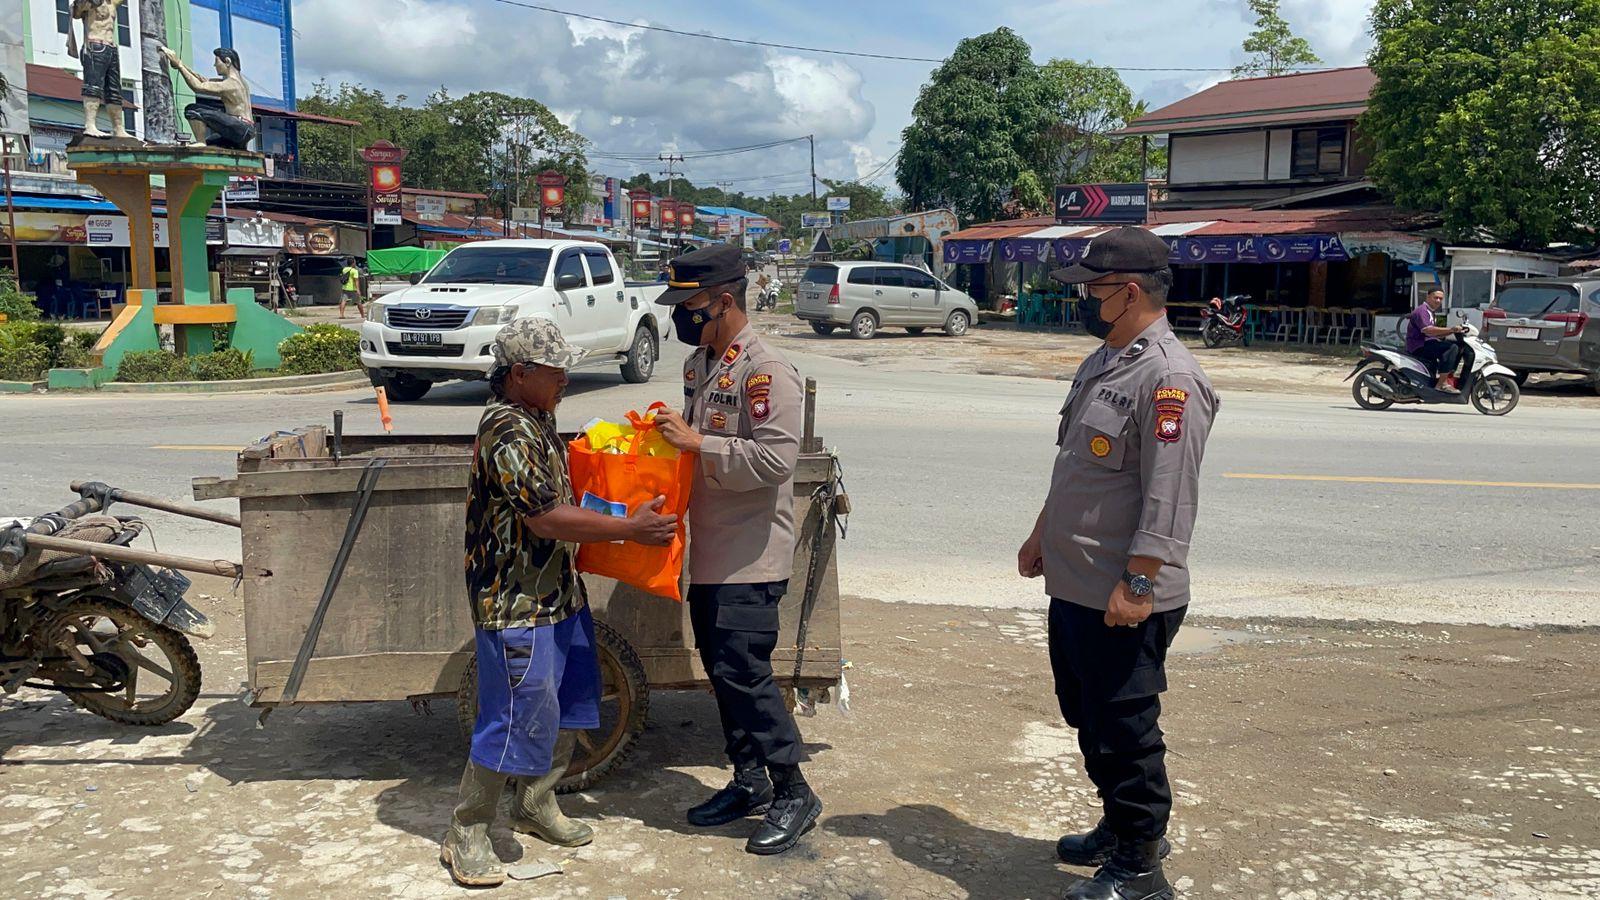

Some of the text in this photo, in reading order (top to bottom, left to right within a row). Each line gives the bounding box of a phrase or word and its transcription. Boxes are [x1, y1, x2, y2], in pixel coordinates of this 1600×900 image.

[376, 194, 400, 206] Surya
[1111, 195, 1146, 206] WARKOP HABIL
[403, 333, 412, 341] DA
[1099, 388, 1132, 409] POLRI
[1157, 389, 1185, 397] POLRES
[708, 392, 737, 406] POLRI
